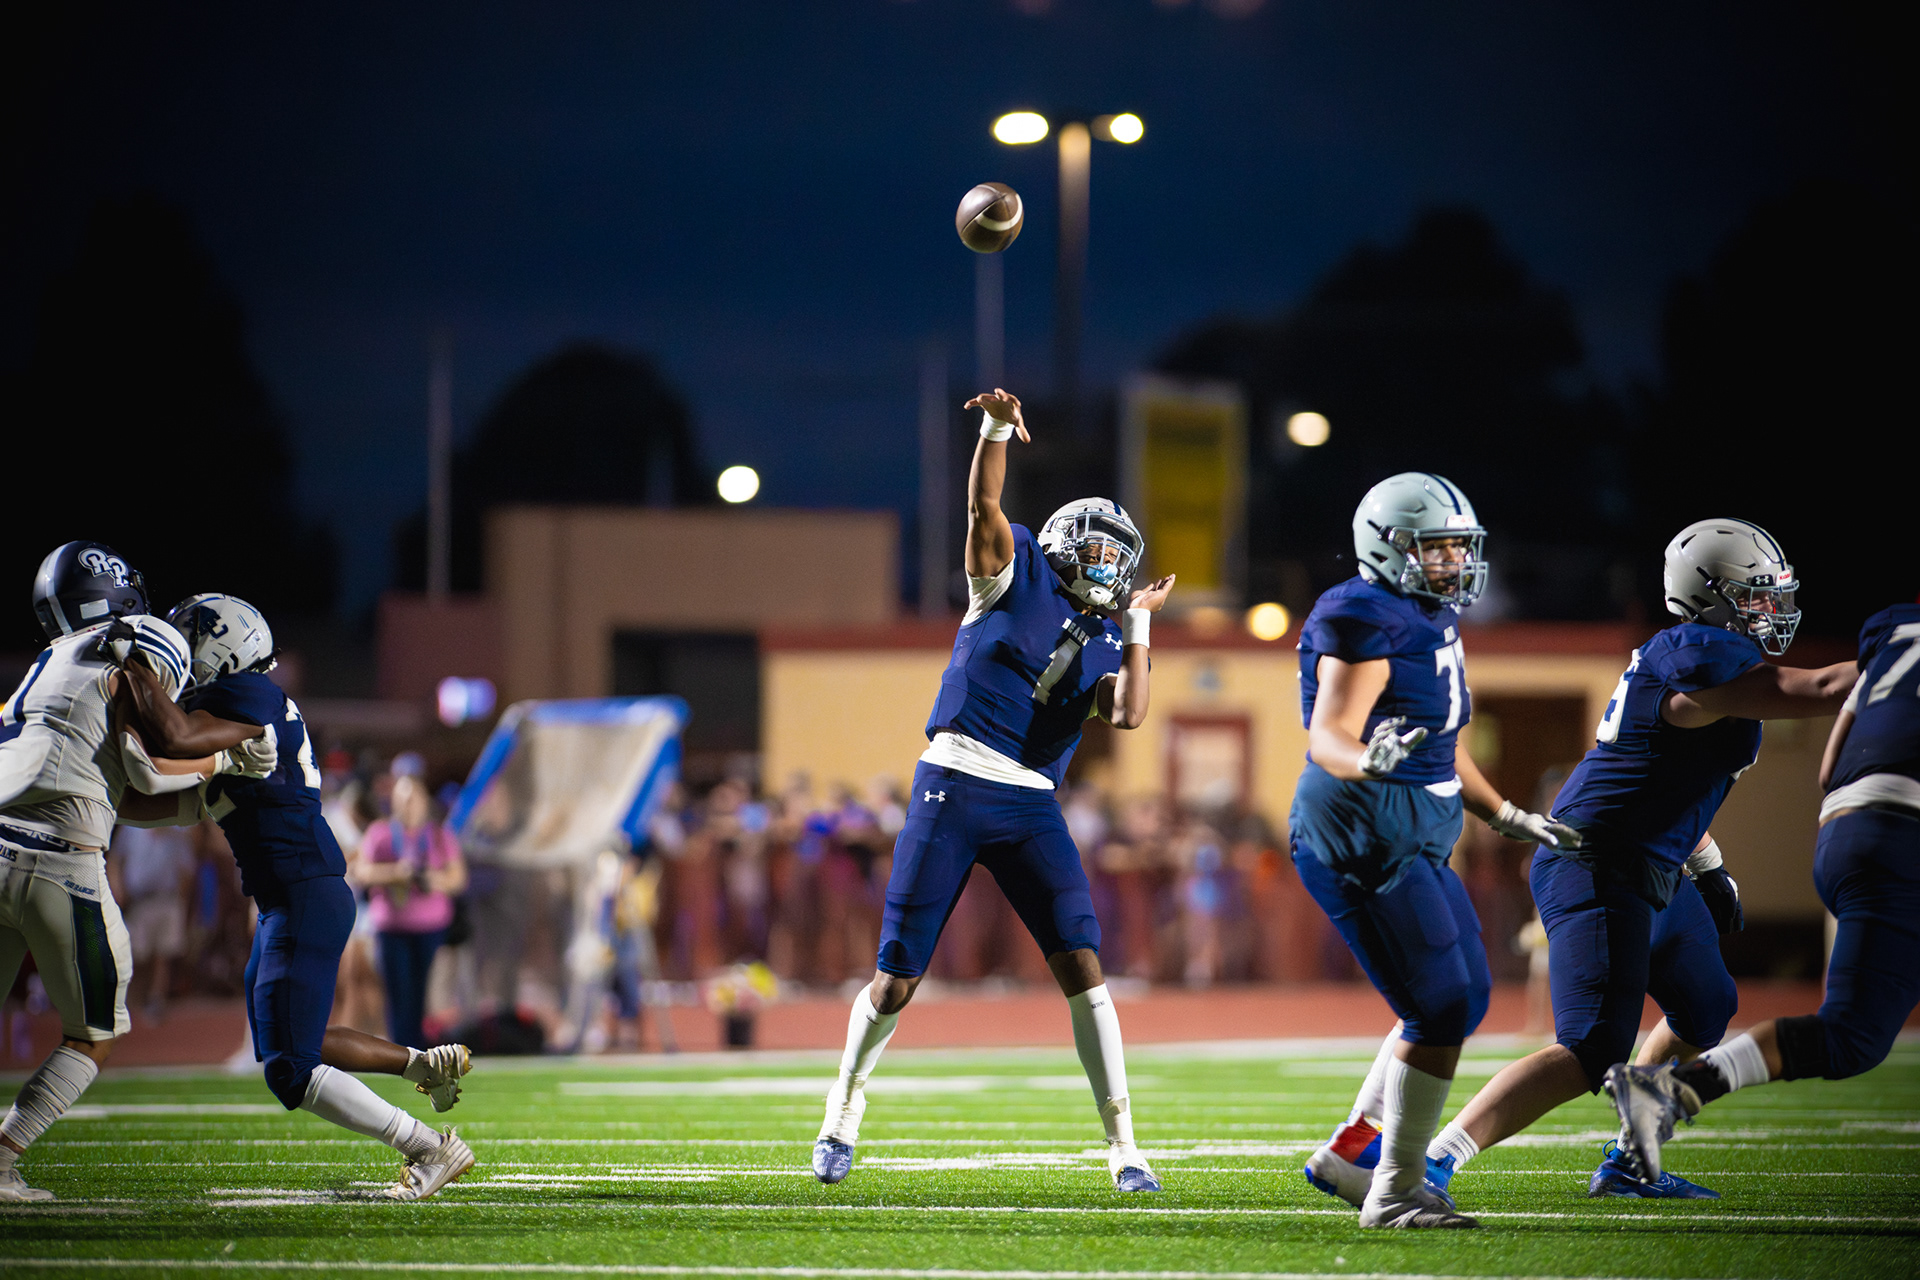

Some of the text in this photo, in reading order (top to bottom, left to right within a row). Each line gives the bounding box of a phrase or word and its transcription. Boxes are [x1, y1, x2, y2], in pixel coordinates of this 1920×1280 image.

[1061, 618, 1091, 647] BEARS
[1866, 622, 1920, 706] 7
[1032, 637, 1081, 705] 1
[1435, 636, 1471, 734] 7
